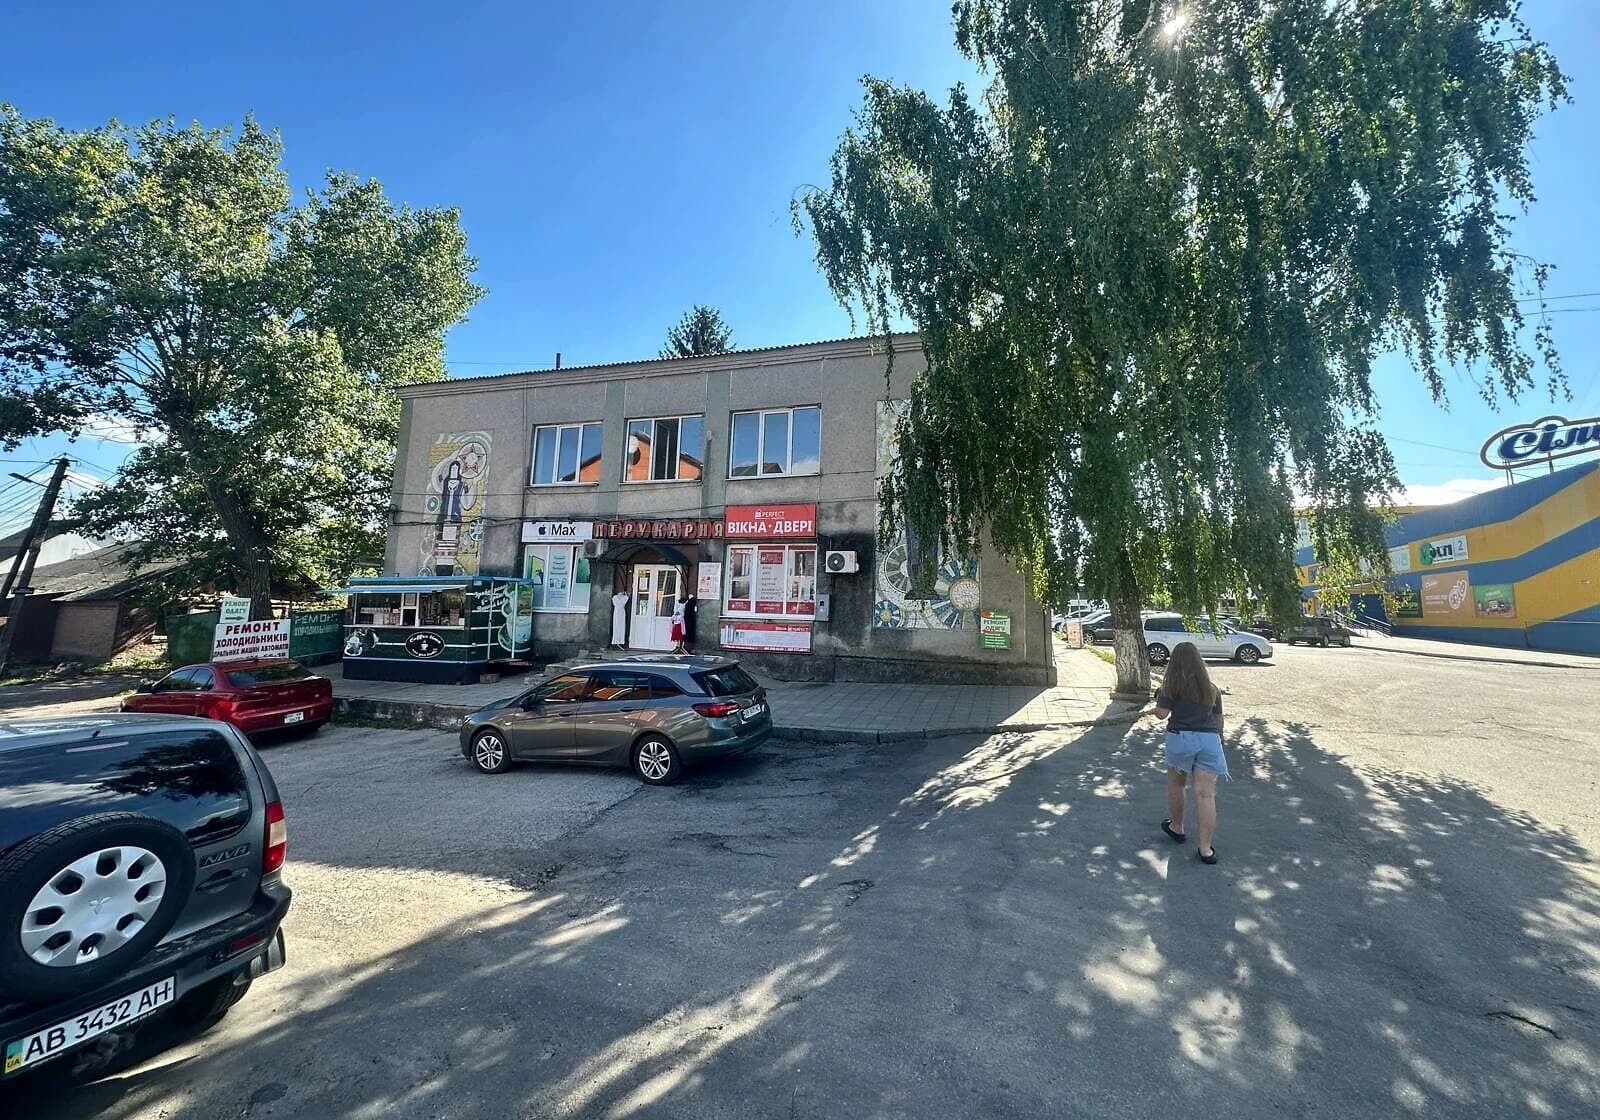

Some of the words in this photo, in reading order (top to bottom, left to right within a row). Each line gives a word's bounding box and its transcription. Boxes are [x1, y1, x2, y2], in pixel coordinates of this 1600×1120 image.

[551, 524, 576, 536] Max
[595, 523, 723, 538] ПЕРУКАРНЯ
[728, 522, 767, 533] ВІКНА
[773, 520, 812, 534] ДВЕРІ
[225, 622, 280, 635] РЕМОНТ
[216, 633, 288, 649] ХОЛОДИЛЬНИКІВ
[24, 1027, 66, 1061] AB
[75, 999, 131, 1039] 3432
[138, 982, 169, 1012] AH
[7, 1059, 20, 1069] UA
